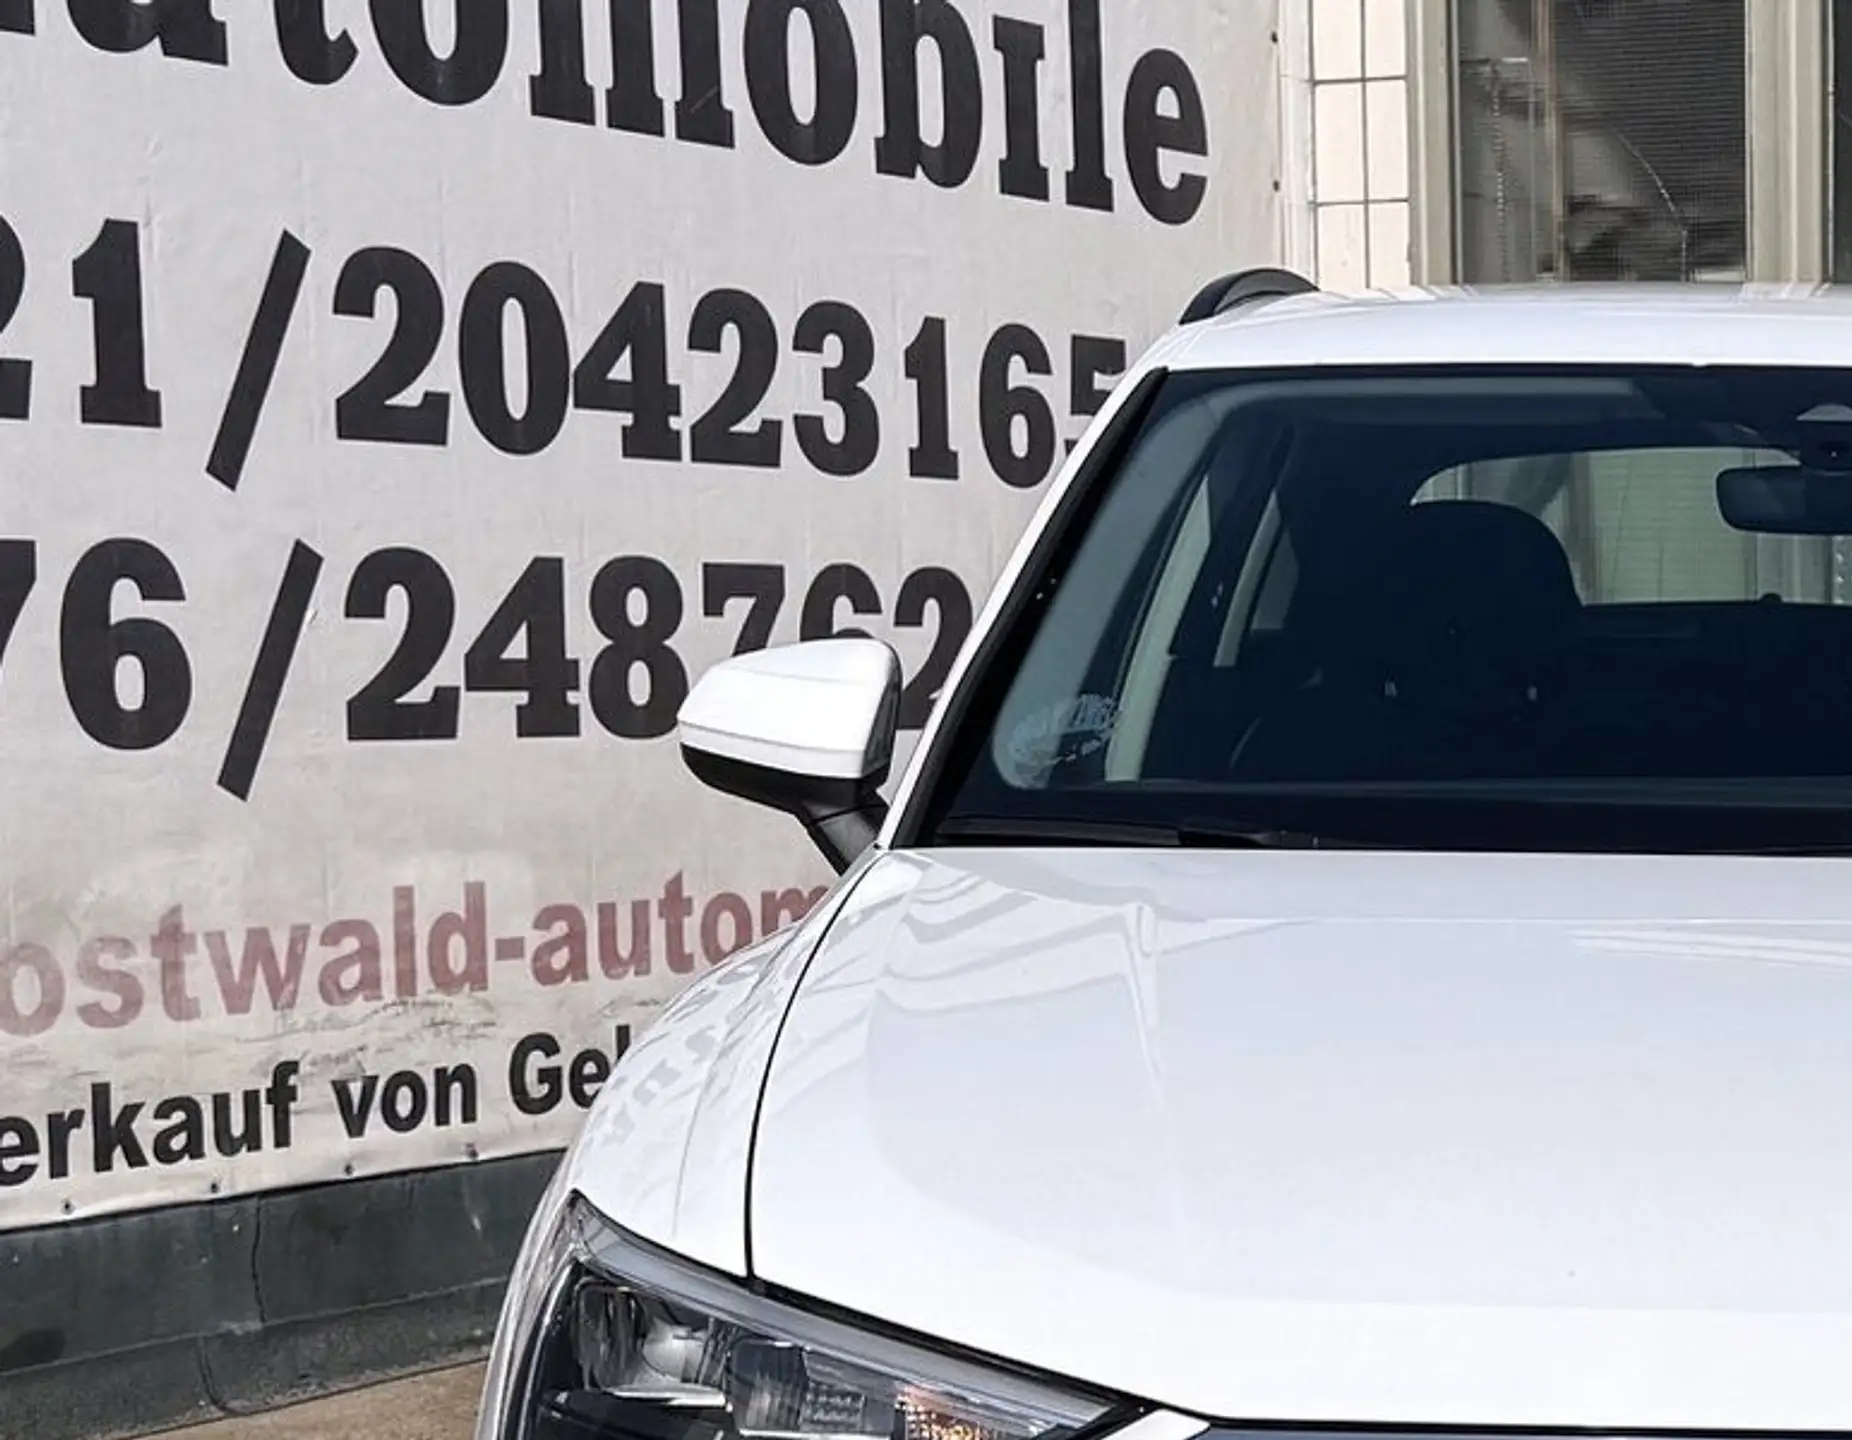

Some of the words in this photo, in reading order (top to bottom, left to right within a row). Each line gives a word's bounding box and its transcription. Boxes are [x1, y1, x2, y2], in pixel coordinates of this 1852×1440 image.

[0, 0, 1209, 224] mobile
[331, 1063, 477, 1139] von
[509, 1024, 631, 1115] Ge
